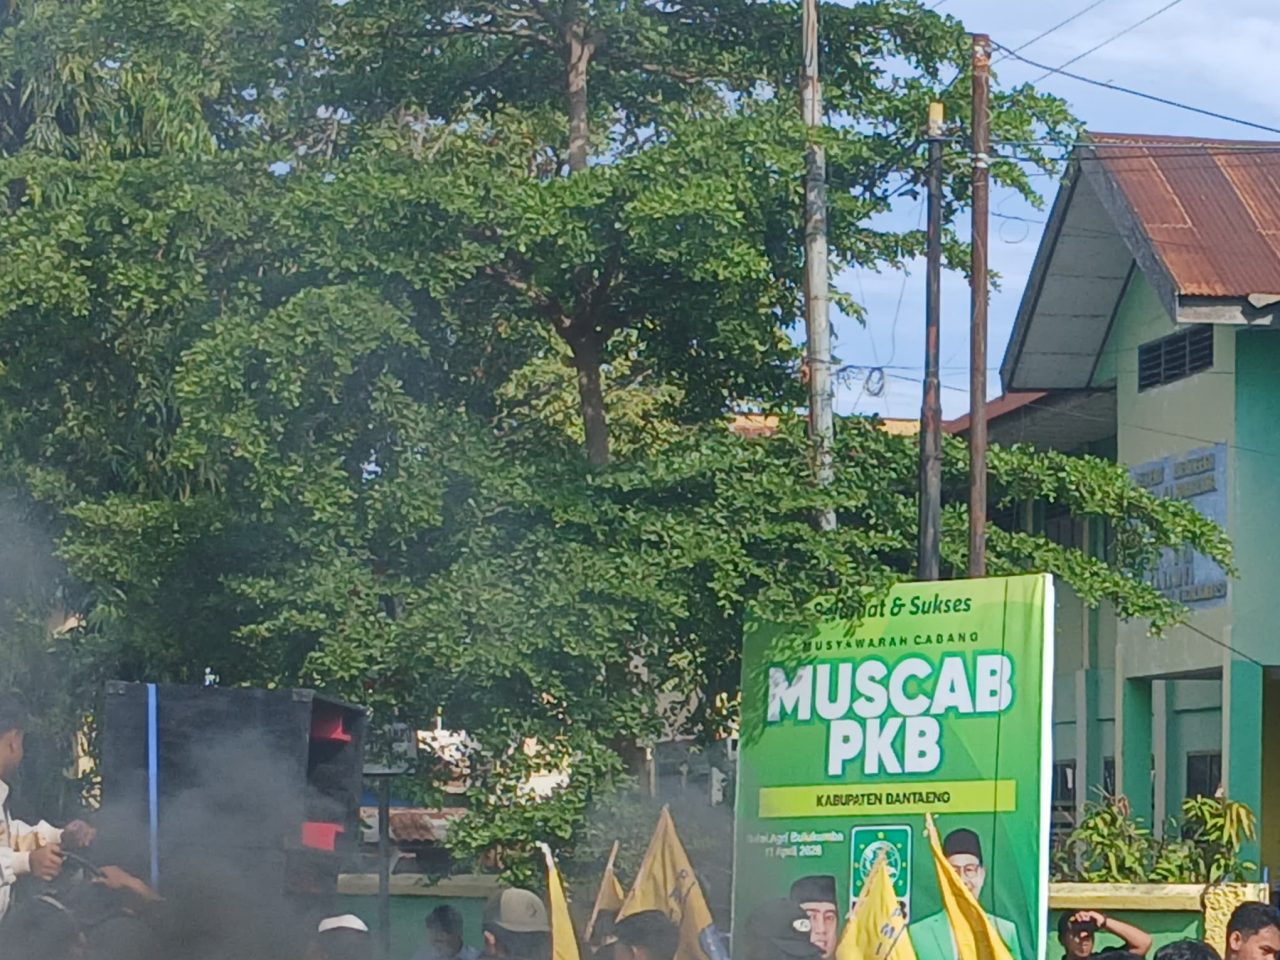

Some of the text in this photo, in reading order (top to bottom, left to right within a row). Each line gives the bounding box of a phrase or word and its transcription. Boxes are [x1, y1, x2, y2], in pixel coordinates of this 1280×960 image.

[890, 597, 906, 617] &
[909, 593, 972, 616] Sukses
[914, 632, 979, 646] CABANG
[767, 654, 1013, 722] MUSCAB
[827, 715, 942, 776] PKB
[816, 791, 951, 807] KABUPATEN BANTAENG
